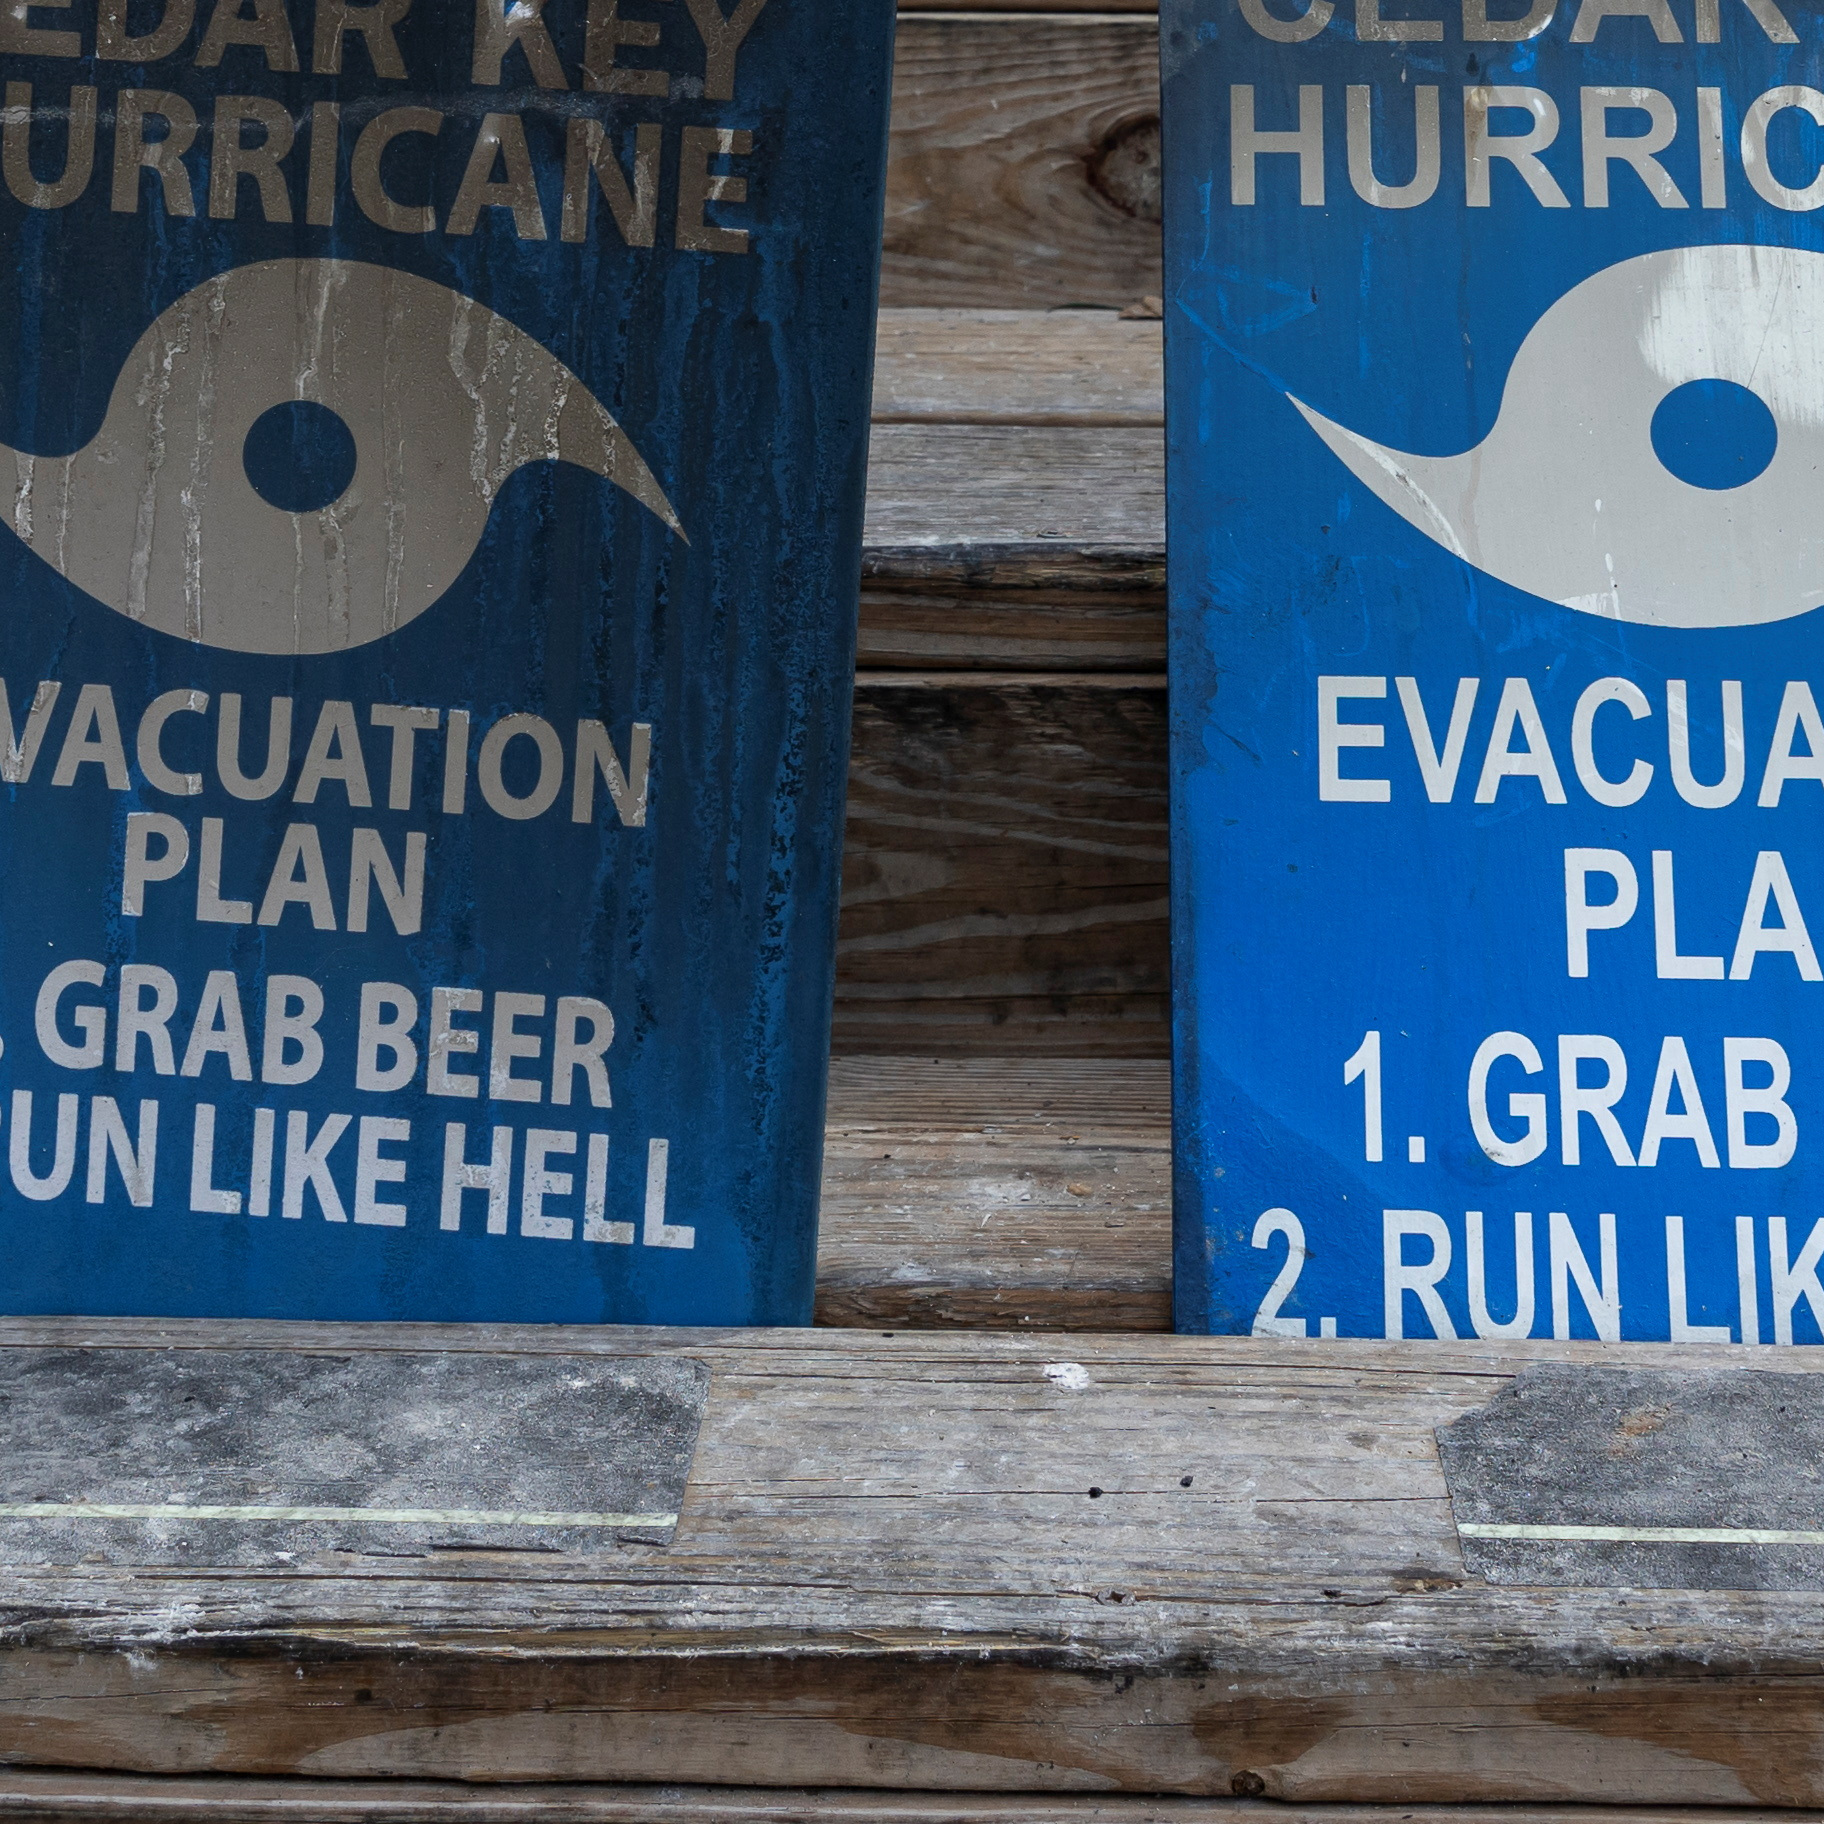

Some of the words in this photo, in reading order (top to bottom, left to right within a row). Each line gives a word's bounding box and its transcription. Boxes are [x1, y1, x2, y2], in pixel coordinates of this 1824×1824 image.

[121, 812, 427, 936] PLAN
[34, 959, 325, 1086] GRAB
[354, 982, 615, 1108] BEER
[1343, 1031, 1426, 1164] 1.
[1468, 1030, 1799, 1169] GRAB
[190, 1103, 410, 1226] LIKE
[439, 1122, 695, 1249] HELL
[1251, 1208, 1337, 1338] 2.
[1383, 1210, 1621, 1342] RUN
